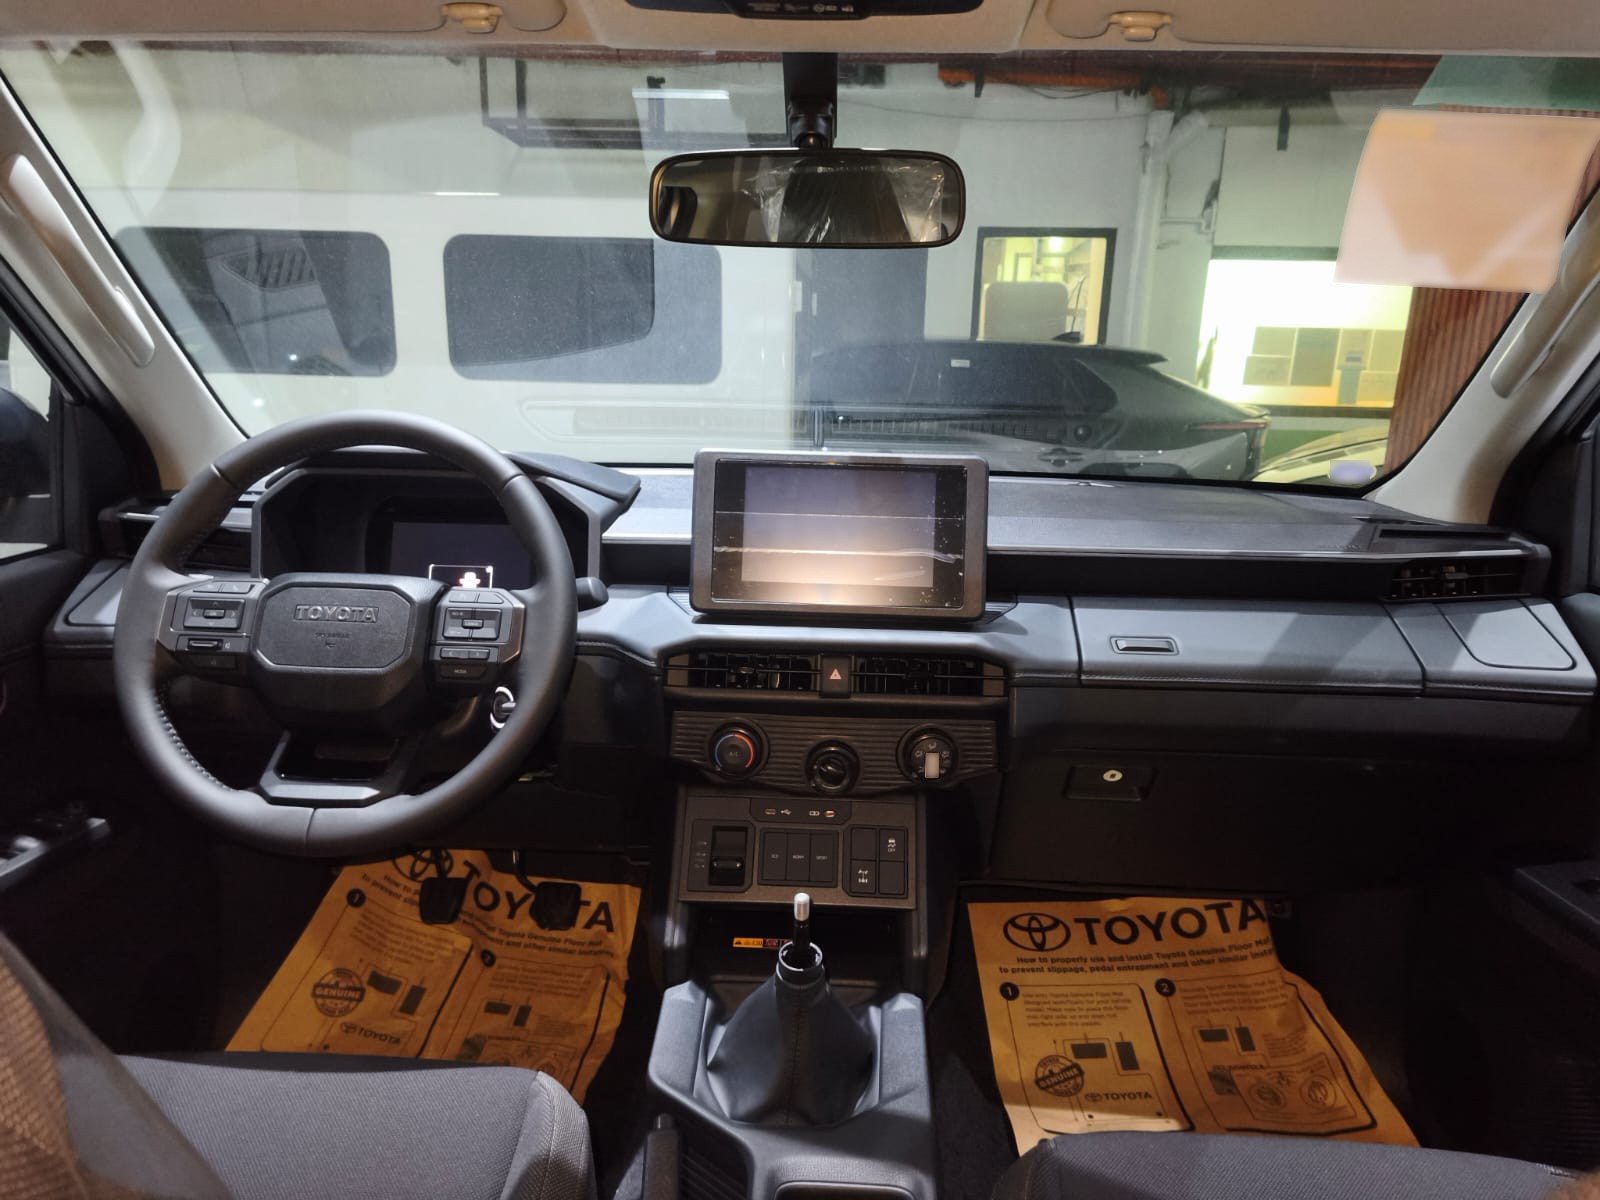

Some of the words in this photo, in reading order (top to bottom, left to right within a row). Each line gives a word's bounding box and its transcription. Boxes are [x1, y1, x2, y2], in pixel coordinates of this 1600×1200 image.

[296, 605, 377, 622] TOYOTA
[464, 860, 614, 932] TOYA
[1074, 898, 1266, 945] TOYOTA
[1050, 955, 1088, 965] properly
[1108, 953, 1125, 962] and
[1155, 951, 1186, 960] Toyota
[1188, 947, 1226, 956] Genuine
[1228, 942, 1253, 952] Floor
[999, 966, 1009, 974] to
[1011, 965, 1044, 974] prevent
[1090, 963, 1115, 972] pedal
[1172, 960, 1189, 968] and
[1191, 958, 1216, 967] other
[316, 988, 360, 999] GENUINE
[358, 1026, 400, 1044] TOYOTA
[1040, 1067, 1079, 1087] GENUINE
[1105, 1091, 1153, 1101] TOYOTA
